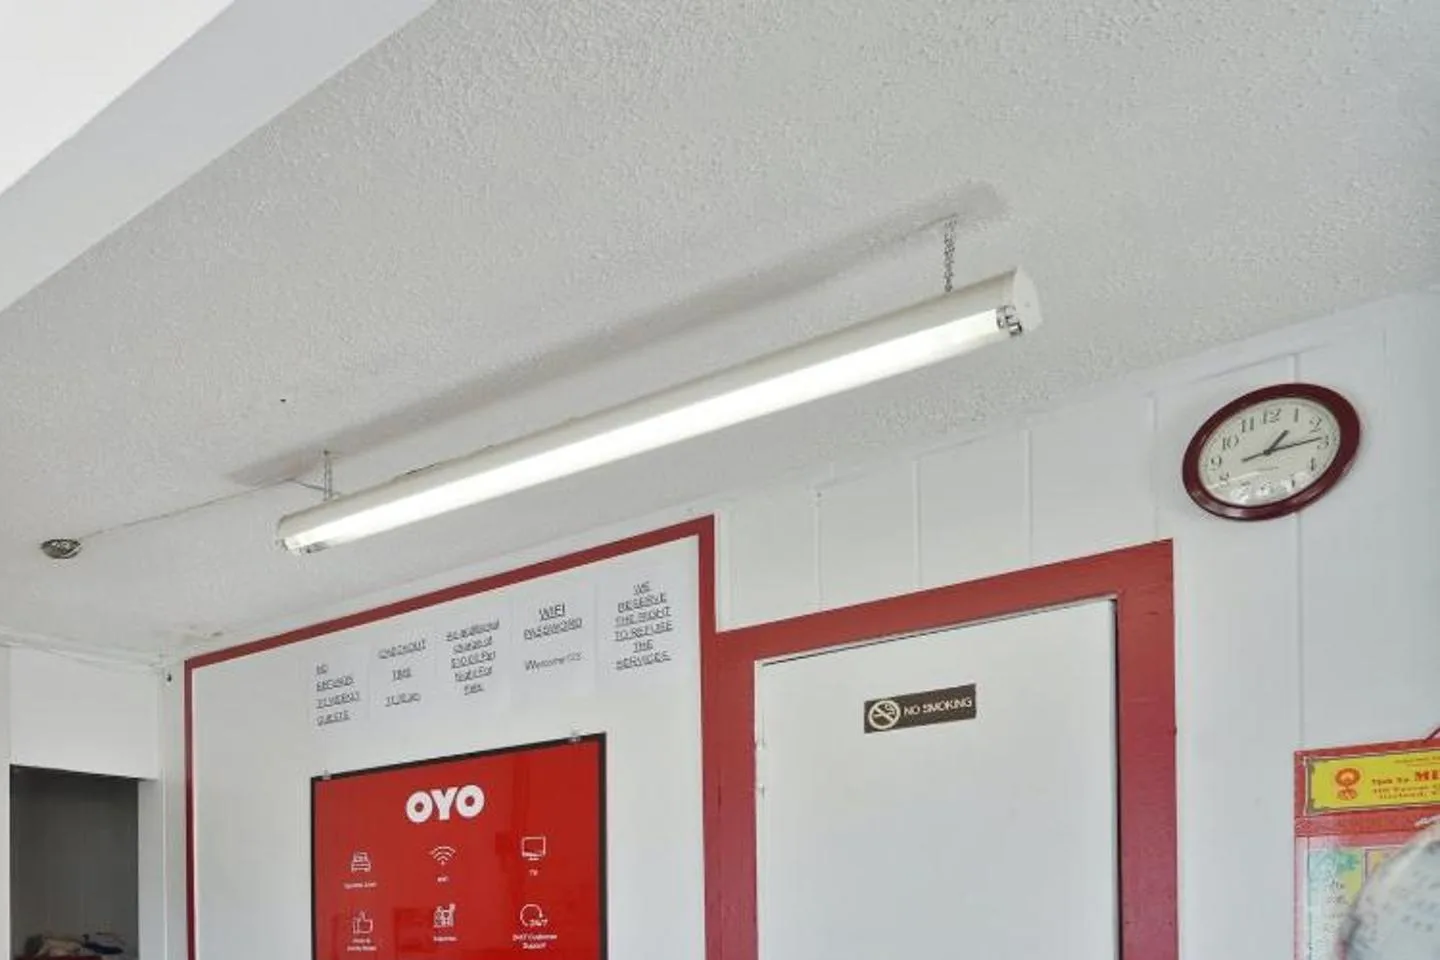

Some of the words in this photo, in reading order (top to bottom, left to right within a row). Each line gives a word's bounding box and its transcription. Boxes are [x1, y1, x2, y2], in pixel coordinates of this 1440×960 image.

[1262, 408, 1282, 425] 12
[1293, 407, 1300, 423] 1
[1241, 417, 1255, 433] 11
[1309, 416, 1323, 433] 2
[1222, 435, 1240, 451] 10
[1211, 456, 1223, 472] 9
[904, 705, 920, 716] NO
[923, 697, 973, 713] SMOKING
[406, 785, 485, 823] OYO
